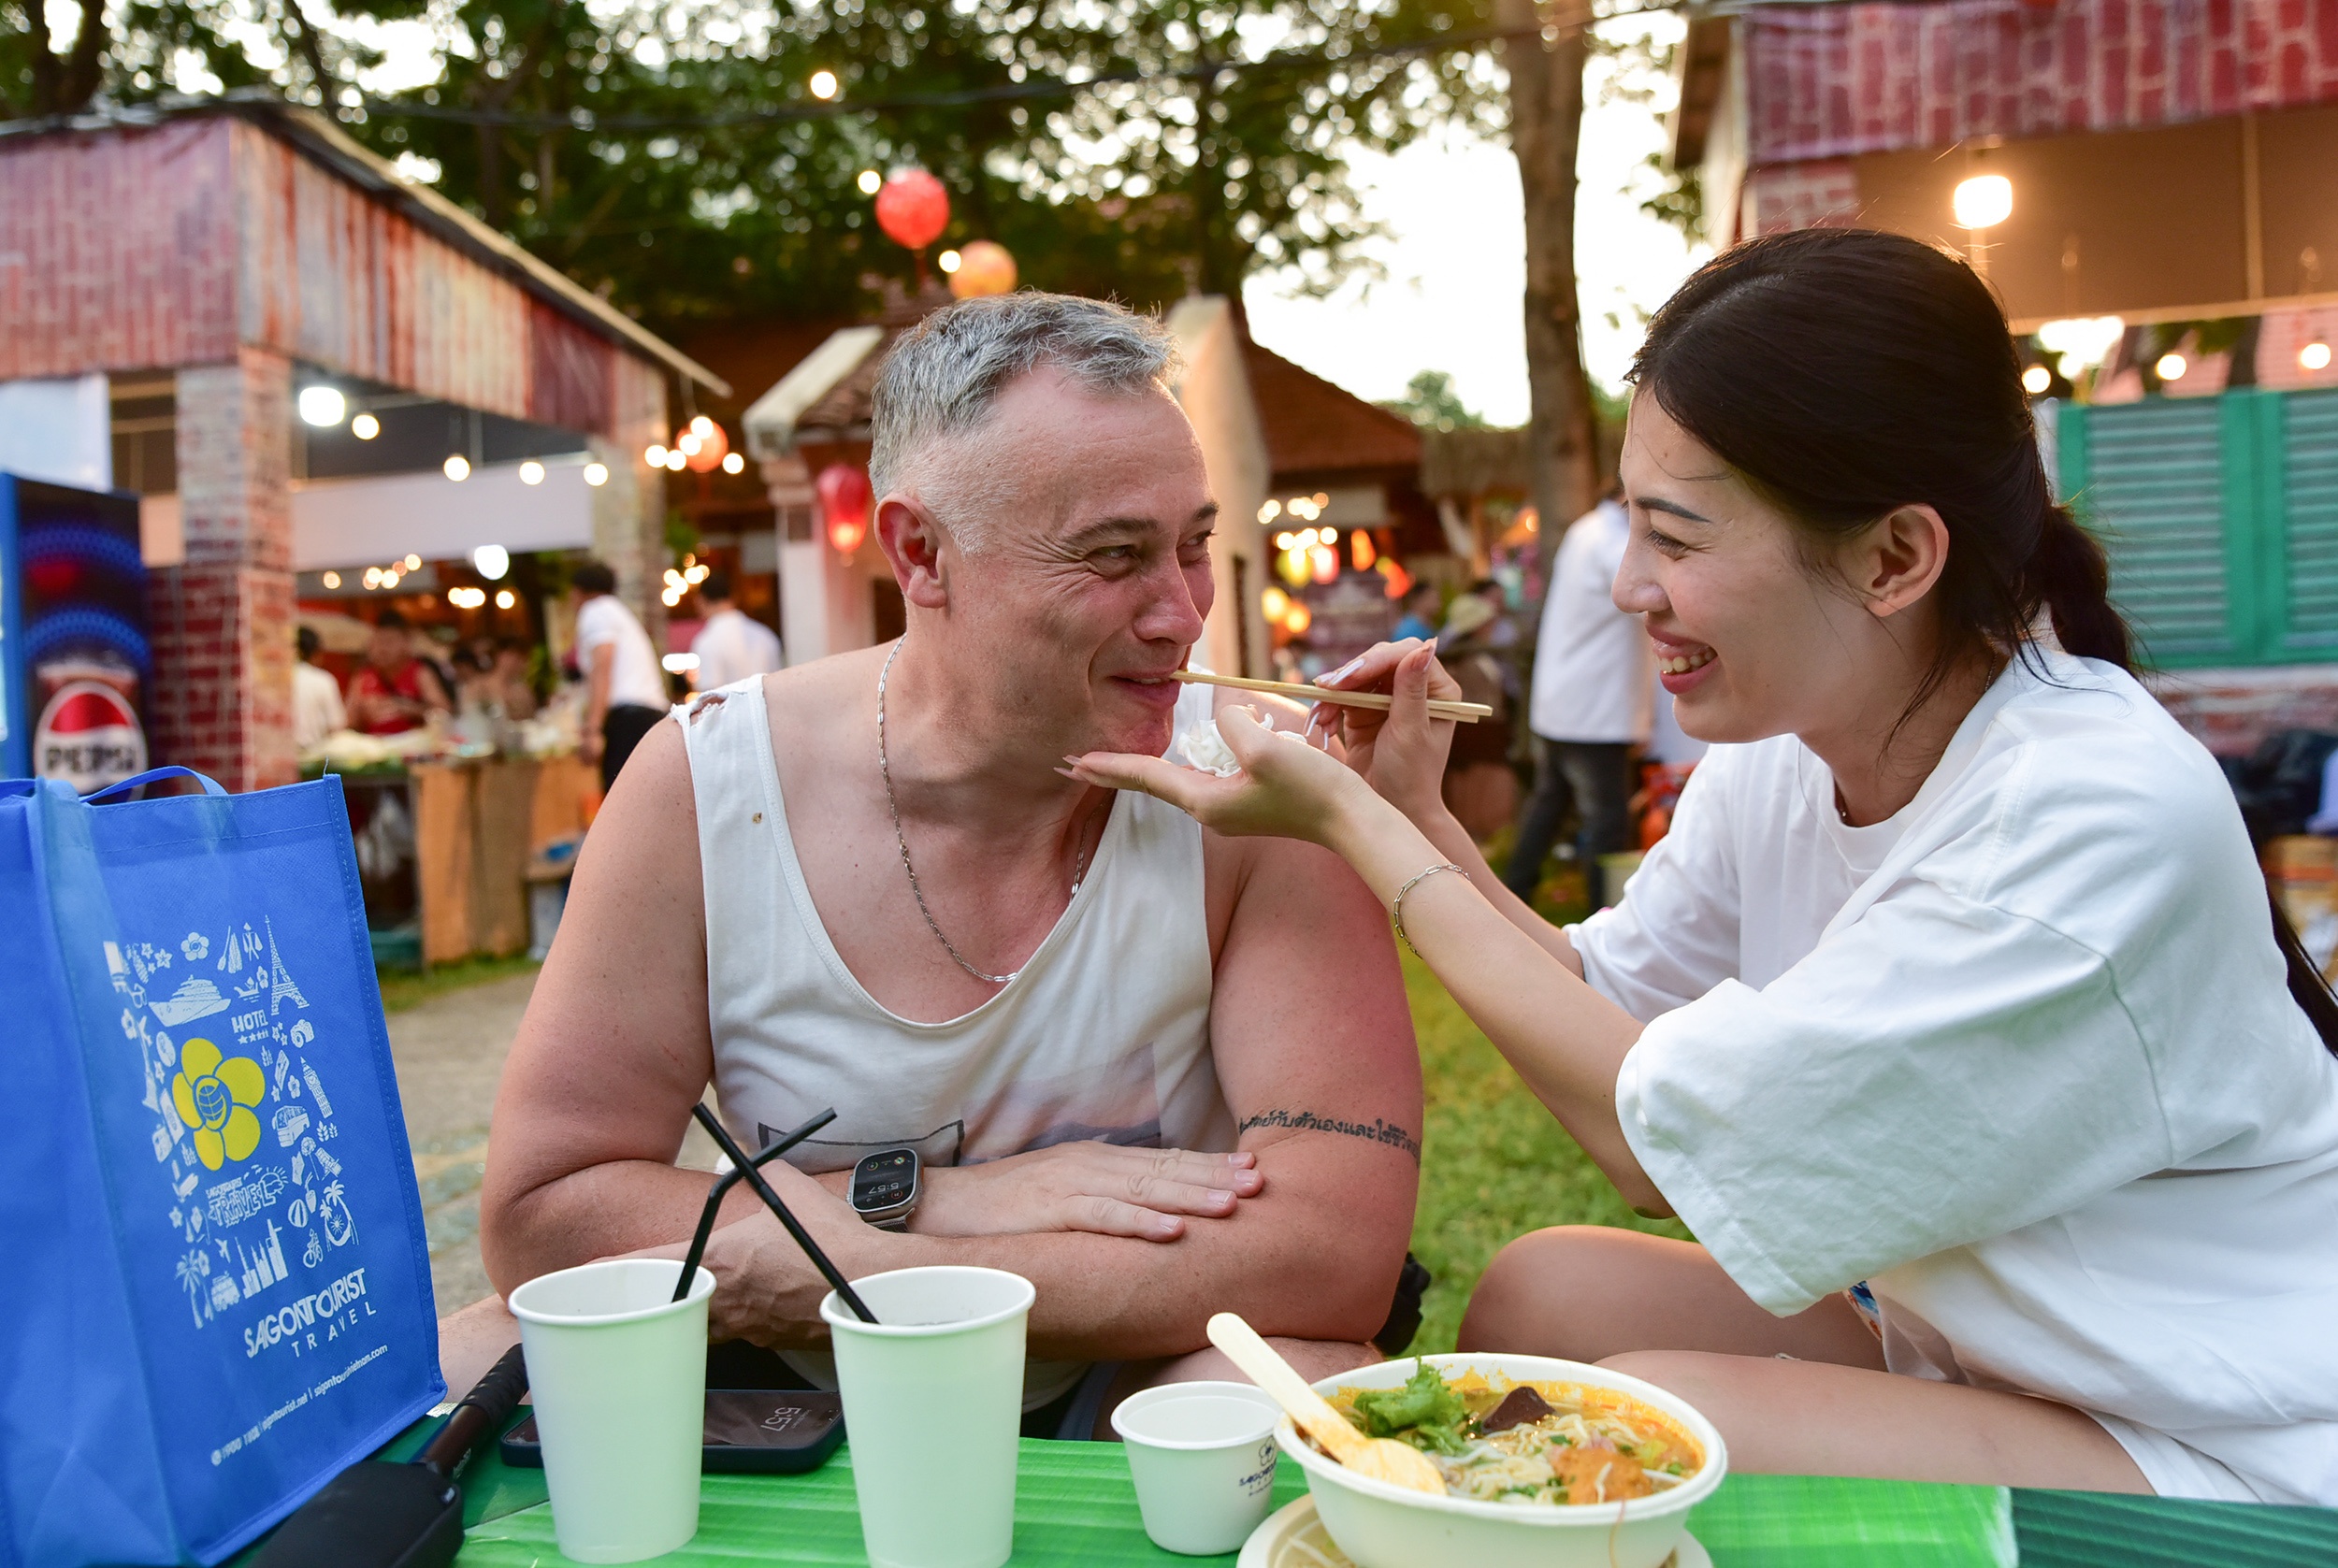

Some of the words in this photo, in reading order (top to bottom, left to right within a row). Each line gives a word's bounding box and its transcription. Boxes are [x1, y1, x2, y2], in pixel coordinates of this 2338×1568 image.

[231, 1009, 268, 1033] HOTEL
[868, 1182, 899, 1194] 5:57
[209, 1180, 277, 1227] TRAVEL
[291, 1301, 376, 1358] TRAVEL
[760, 1406, 801, 1431] 5:57
